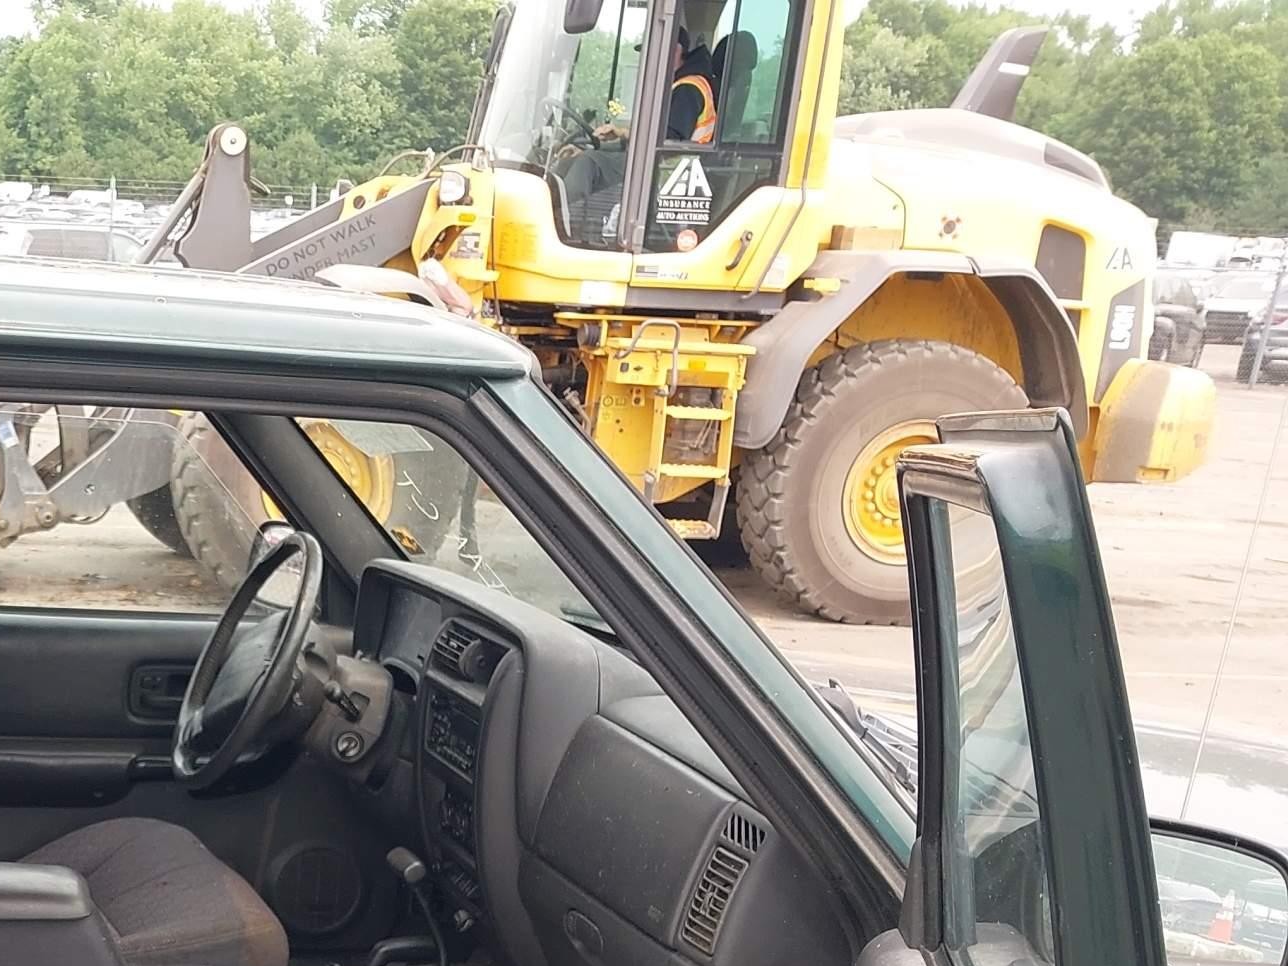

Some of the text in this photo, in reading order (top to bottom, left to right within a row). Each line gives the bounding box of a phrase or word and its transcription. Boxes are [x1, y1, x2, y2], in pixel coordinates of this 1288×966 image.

[656, 211, 710, 221] AUTO AUCTIONS
[658, 199, 711, 209] INSURANCE
[265, 214, 376, 276] DO NOT WALK
[289, 233, 376, 280] NDER MAST
